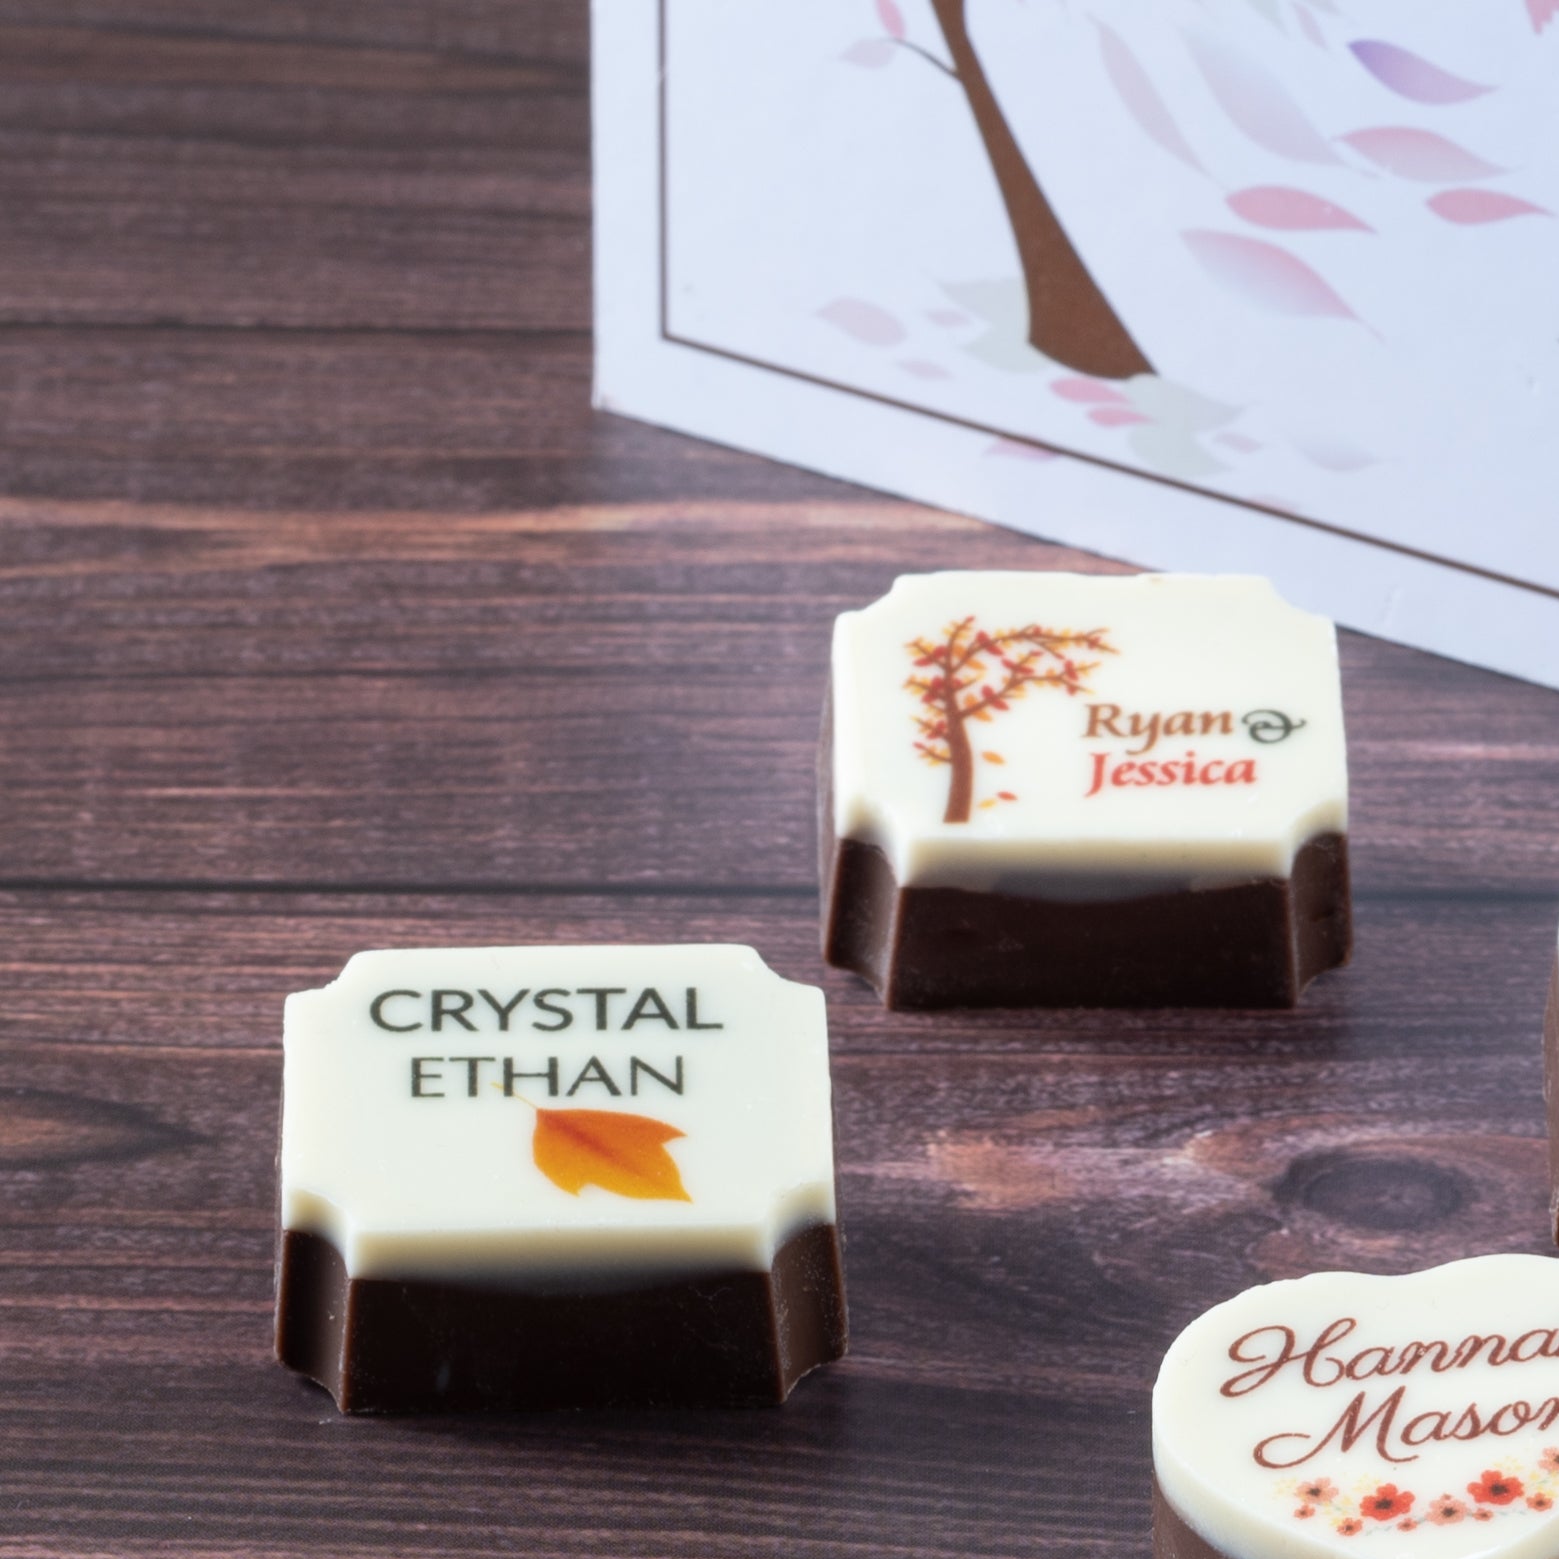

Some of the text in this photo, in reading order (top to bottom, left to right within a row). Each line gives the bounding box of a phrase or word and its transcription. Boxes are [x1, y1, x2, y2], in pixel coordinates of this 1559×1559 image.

[1082, 703, 1233, 755] Ryan
[1085, 751, 1257, 797] Jessica
[369, 987, 724, 1032] CRYSTAL
[410, 1055, 685, 1098] ETHAN
